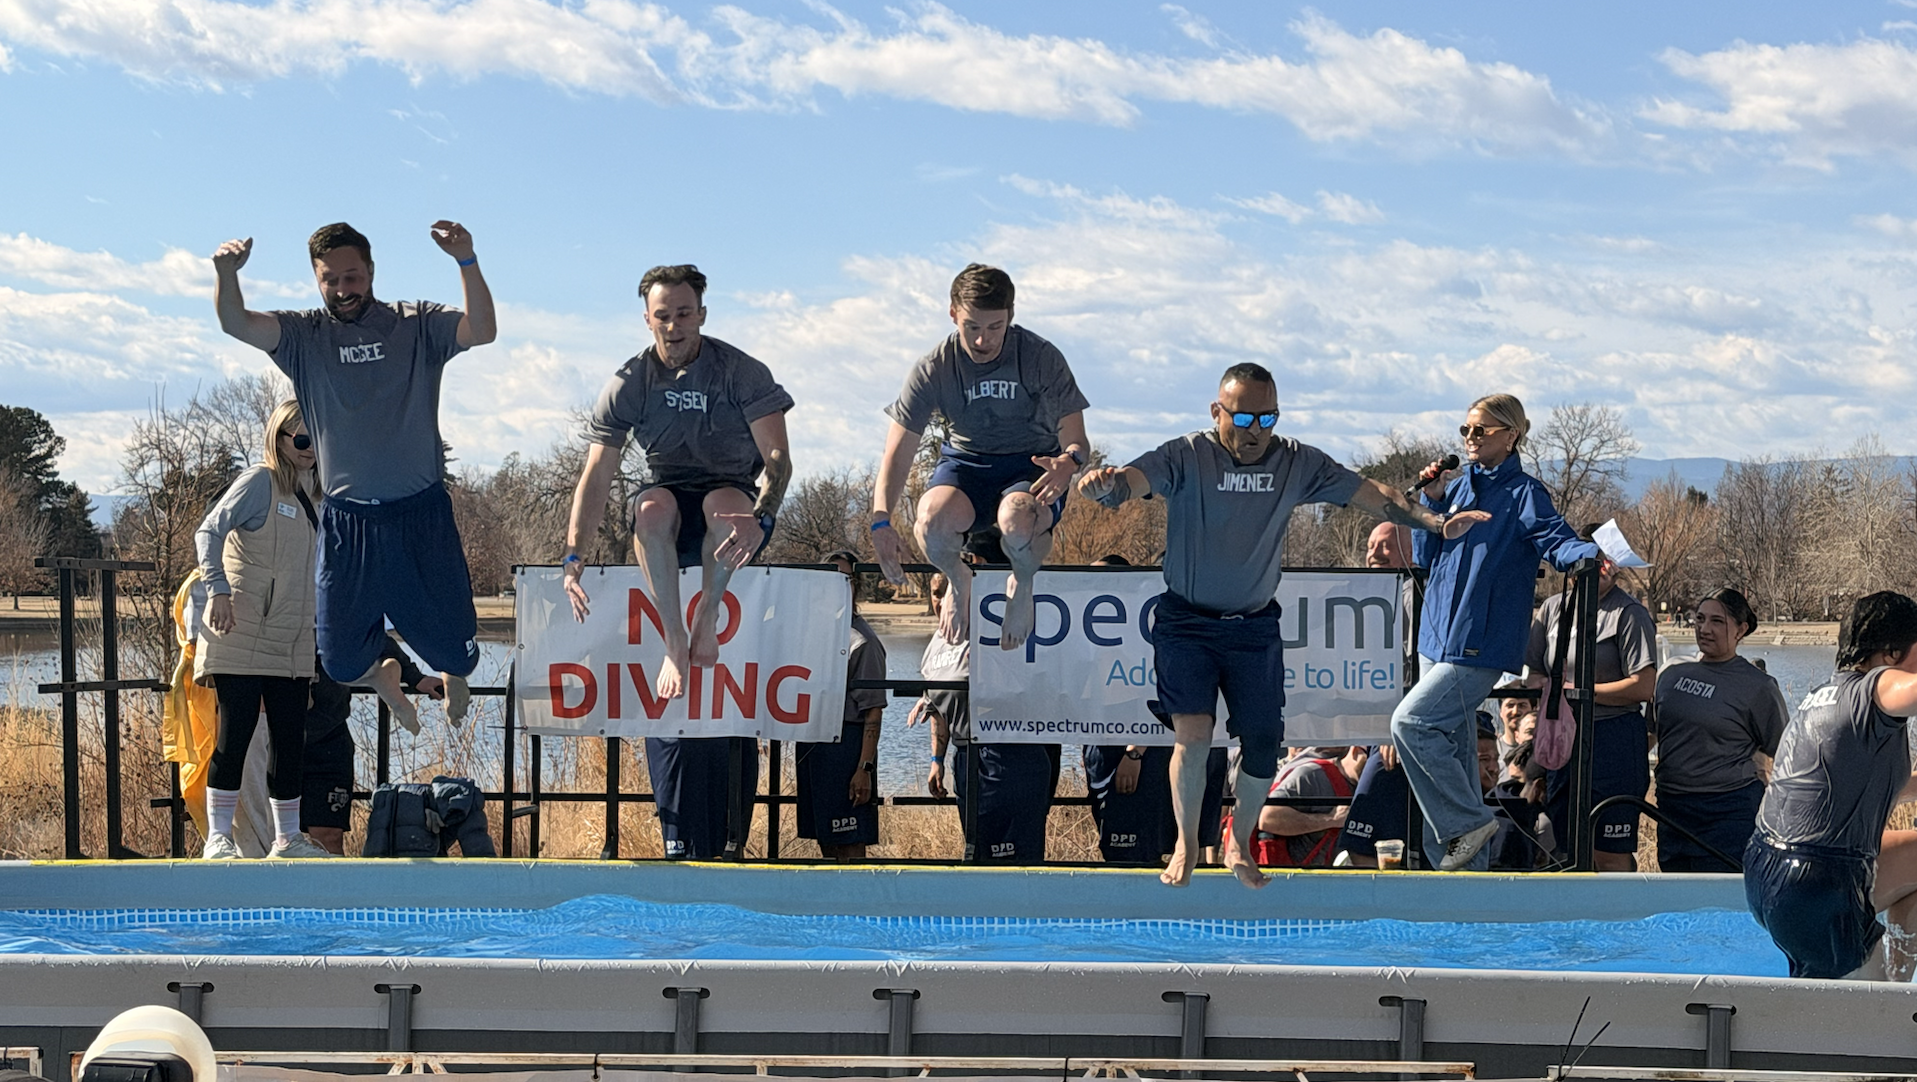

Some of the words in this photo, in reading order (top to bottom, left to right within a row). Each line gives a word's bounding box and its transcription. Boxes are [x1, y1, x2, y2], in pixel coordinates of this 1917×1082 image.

[1217, 472, 1275, 492] JIMENEZ
[628, 588, 741, 645] NO
[1305, 663, 1335, 689] to
[1343, 660, 1395, 689] life!
[549, 662, 812, 724] DIVING
[1674, 677, 1716, 699] ACOSTA
[979, 719, 1165, 735] www.spectrumco.com
[832, 817, 857, 828] DPD
[1348, 820, 1373, 833] DPD
[1605, 824, 1631, 833] DPD
[1111, 833, 1137, 842] DPD
[991, 843, 1015, 853] DPD
